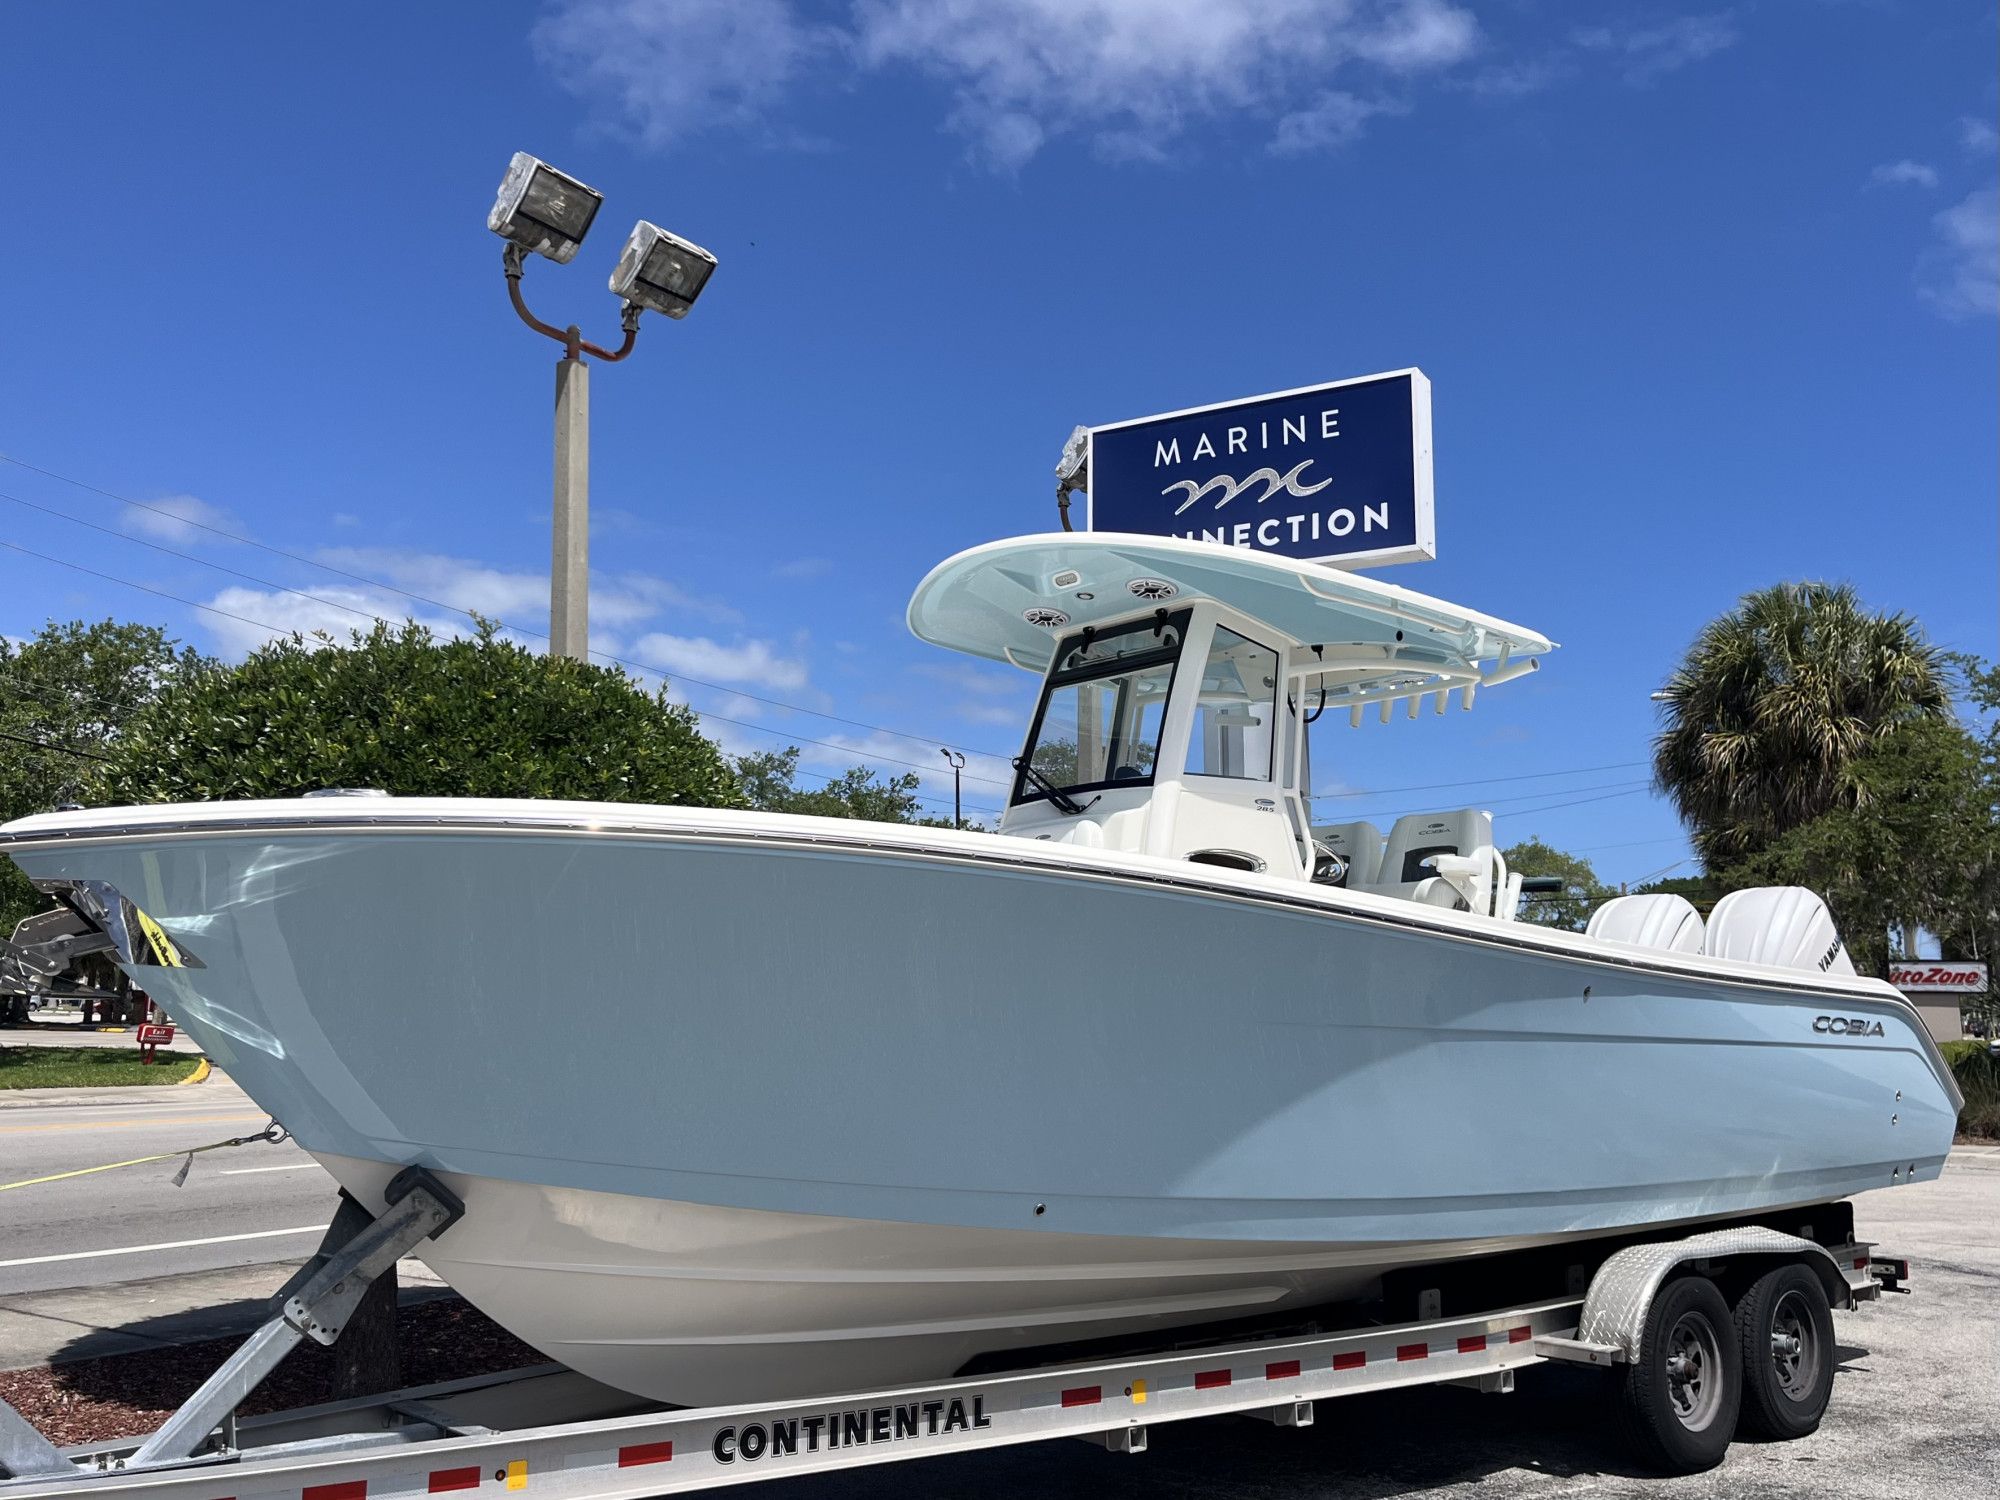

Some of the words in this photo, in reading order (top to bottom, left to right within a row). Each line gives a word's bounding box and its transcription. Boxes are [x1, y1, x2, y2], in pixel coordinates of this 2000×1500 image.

[1154, 409, 1340, 467] MARINE
[1171, 502, 1389, 549] NECTION
[1889, 968, 1979, 987] utoZone
[1812, 1015, 1885, 1038] COBIA
[711, 1394, 992, 1466] CONTINENTAL
